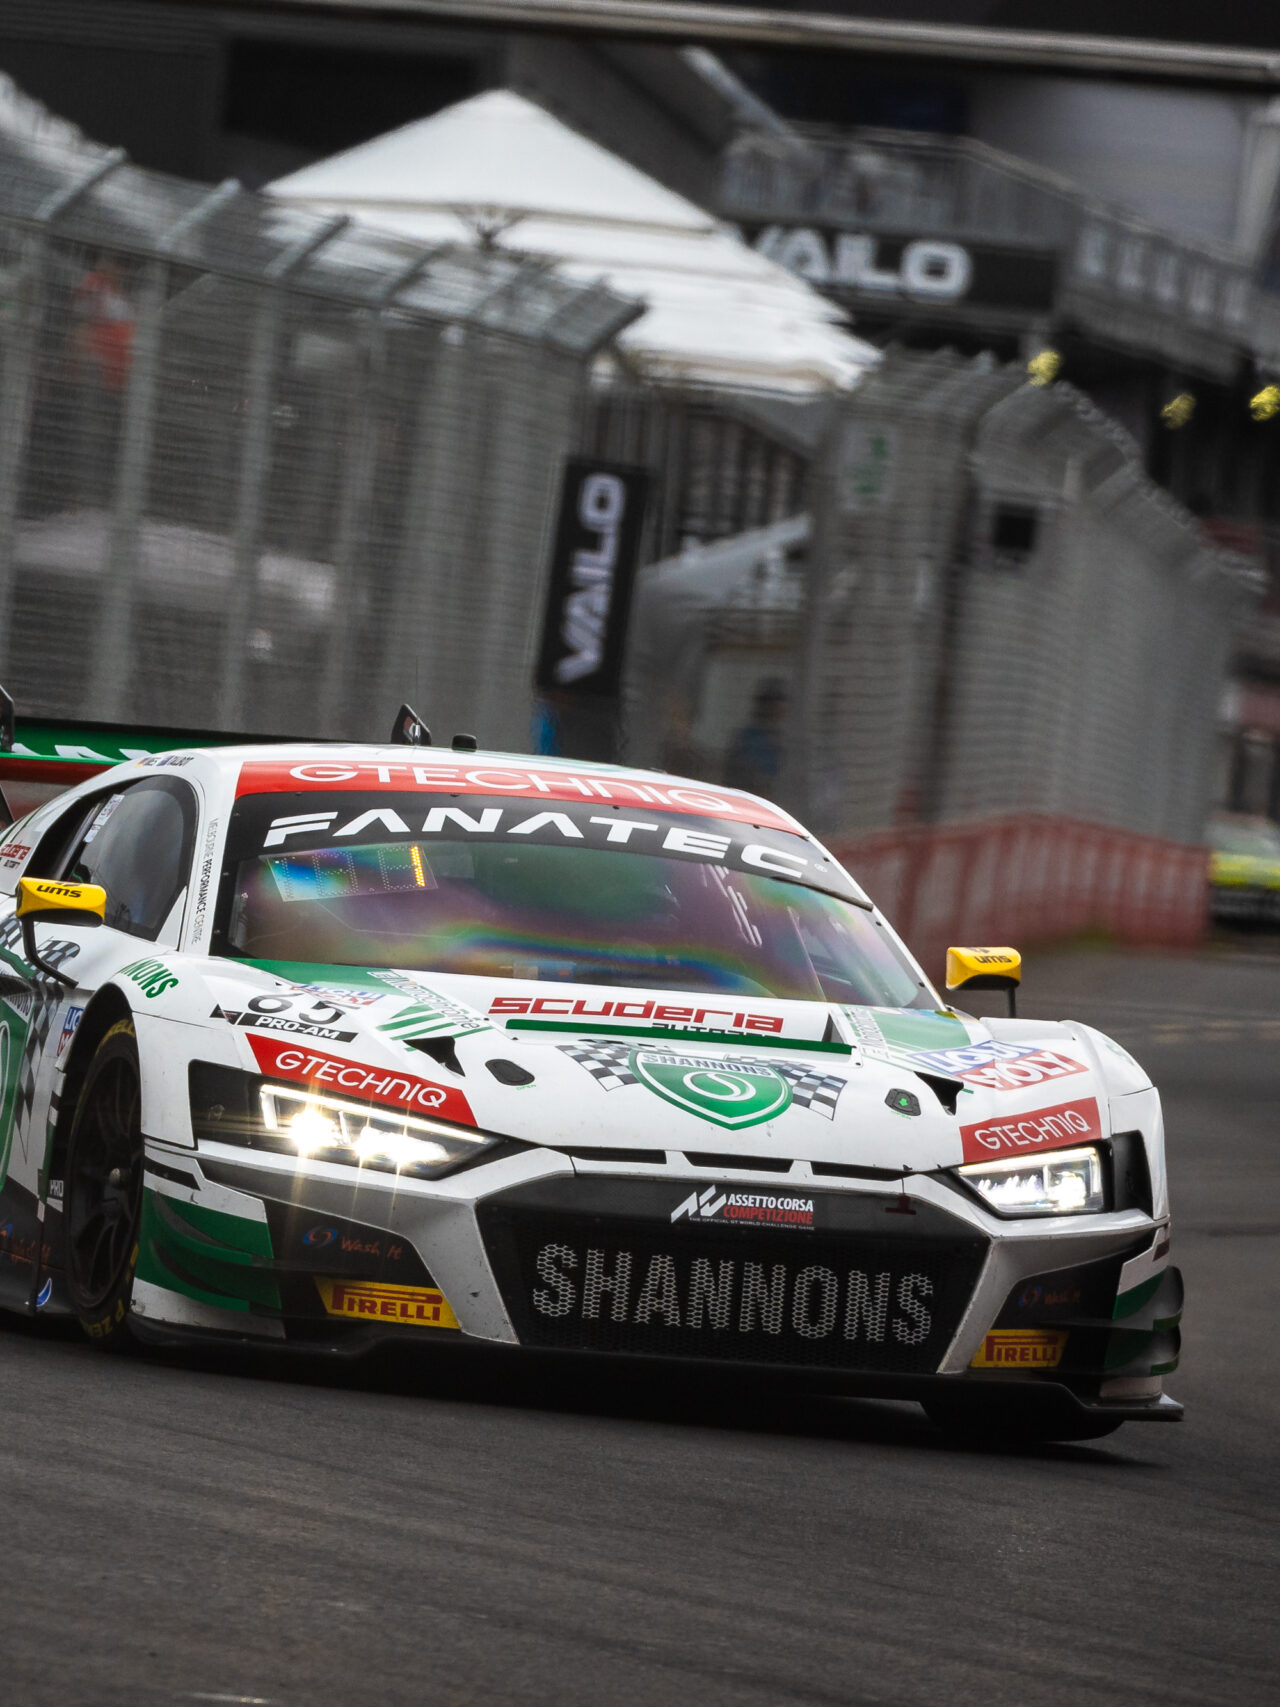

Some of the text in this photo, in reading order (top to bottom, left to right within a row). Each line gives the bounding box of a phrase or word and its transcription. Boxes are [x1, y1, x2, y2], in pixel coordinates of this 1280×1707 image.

[552, 472, 626, 684] VAILO
[290, 763, 739, 814] GTECHNIQ
[263, 807, 808, 878] FANATEC
[36, 884, 83, 898] ums
[974, 955, 1013, 964] ums
[255, 1016, 341, 1041] PRO-AM
[488, 996, 784, 1034] scuderia
[642, 1052, 774, 1077] SHANNONS
[914, 1040, 1034, 1074] LIQUI
[962, 1050, 1077, 1089] MOLY
[275, 1050, 447, 1108] GTECHNIQ
[974, 1109, 1092, 1150] GTECHNIQ
[723, 1205, 814, 1225] COMPETIZIONE
[727, 1193, 814, 1212] ASSETTO CORSA
[332, 1284, 442, 1322] PIRELLI
[532, 1243, 934, 1345] SHANNONS
[985, 1335, 1058, 1362] PIRELLI
